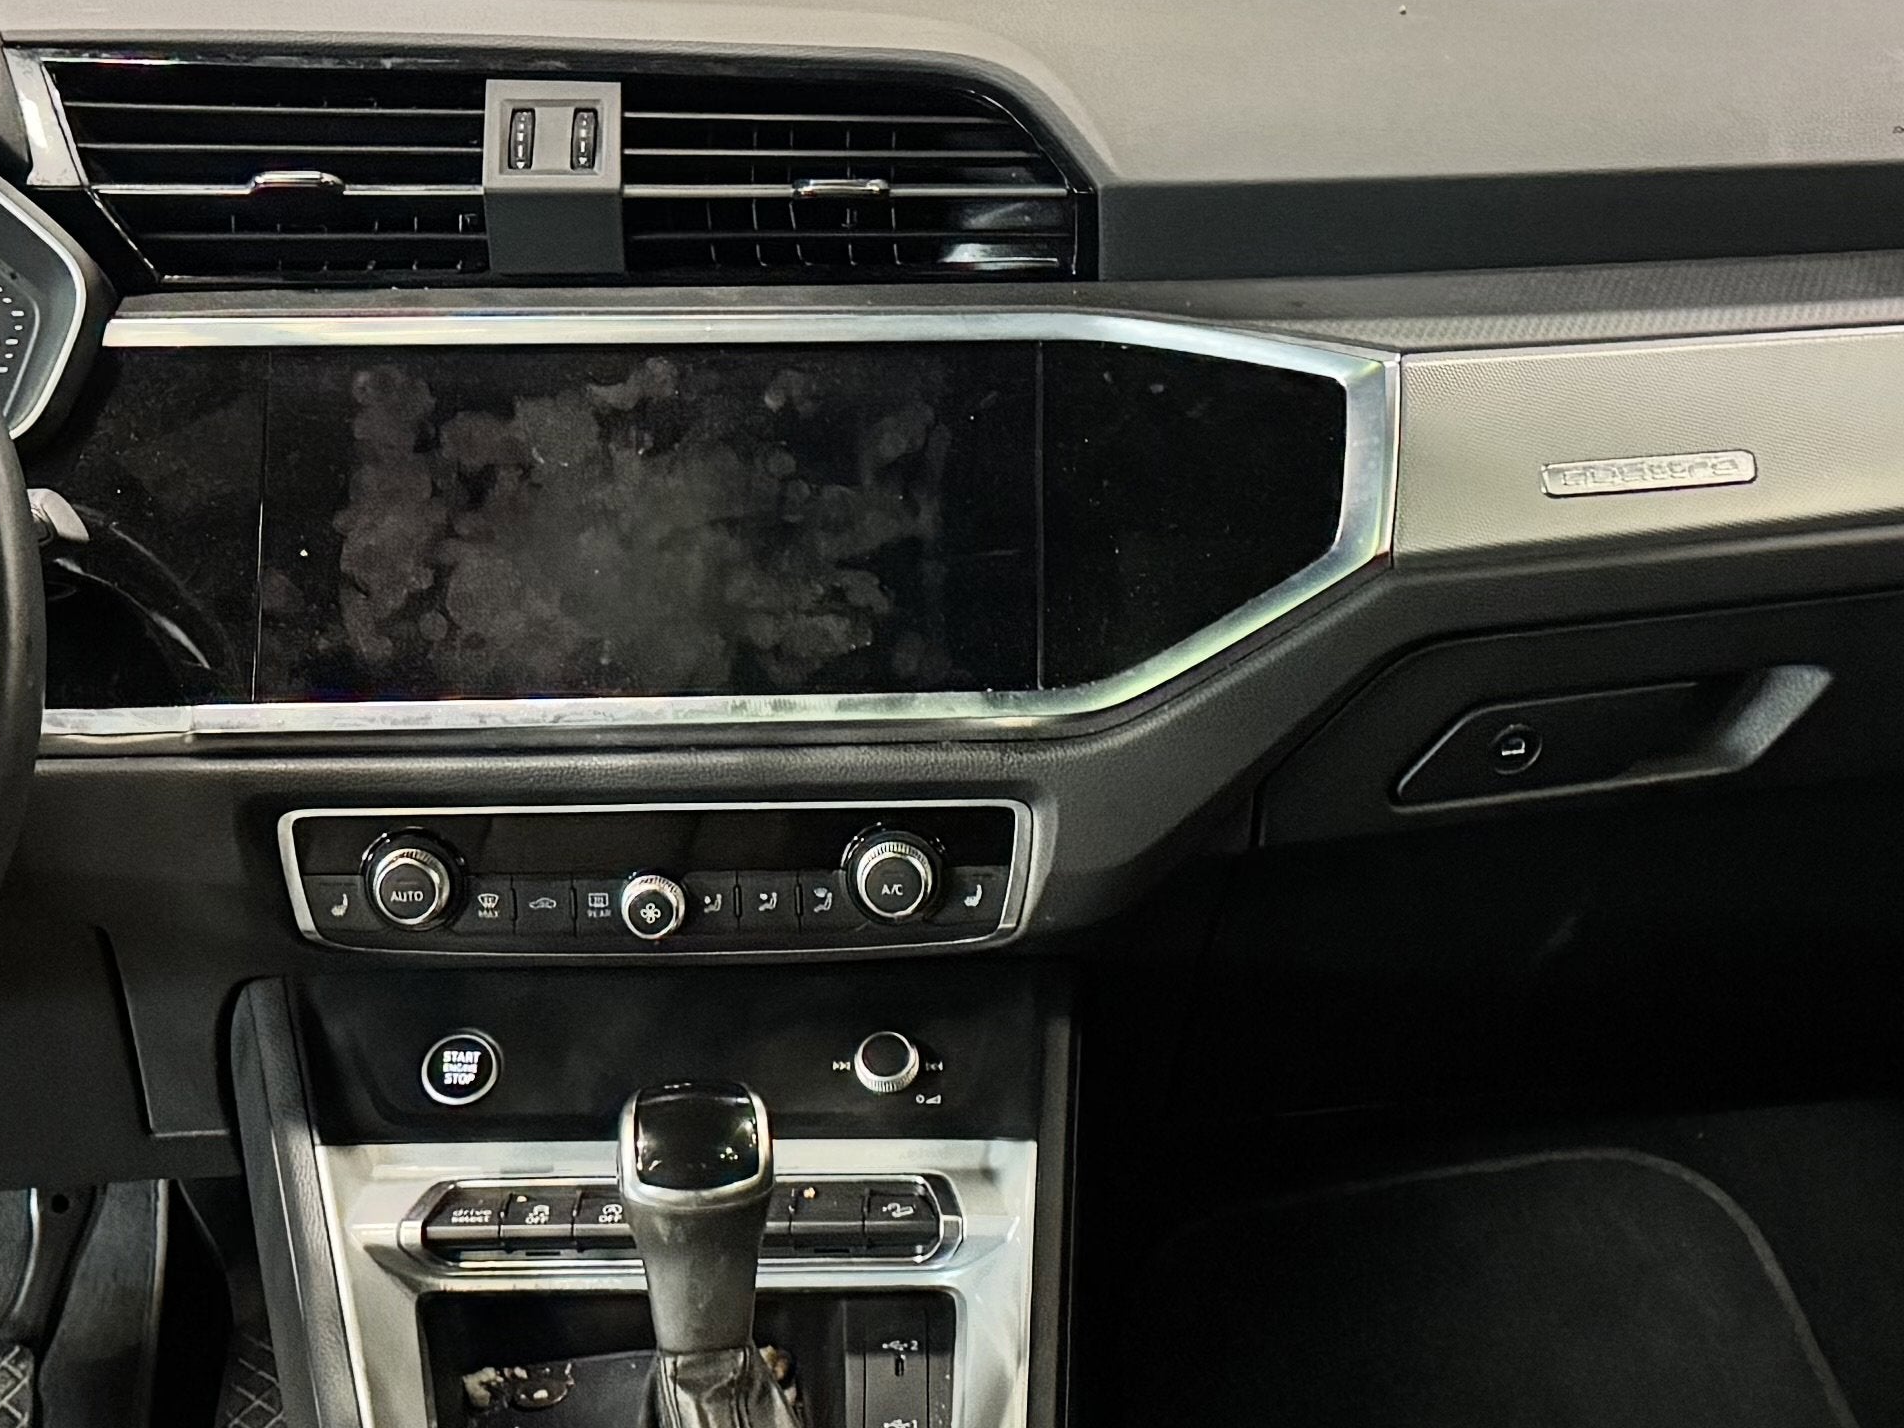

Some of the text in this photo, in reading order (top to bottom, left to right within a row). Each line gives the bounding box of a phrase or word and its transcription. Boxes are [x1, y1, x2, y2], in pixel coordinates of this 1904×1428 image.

[390, 889, 424, 903] AUTO
[881, 883, 904, 896] A/C
[442, 1050, 482, 1064] START
[443, 1072, 476, 1086] STOP
[909, 1339, 919, 1351] 2
